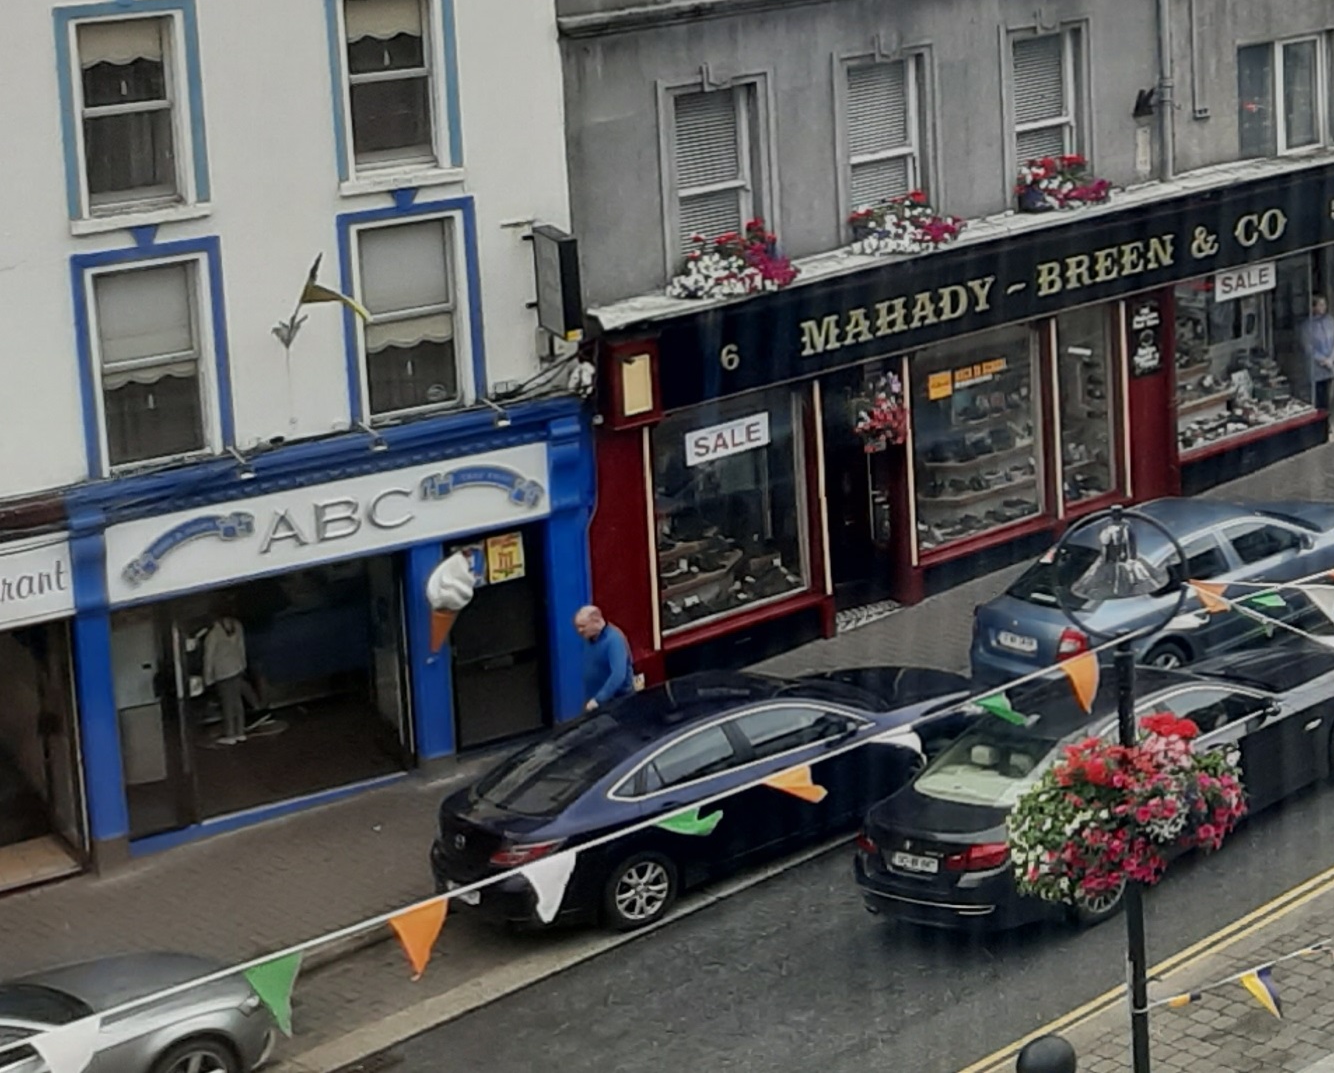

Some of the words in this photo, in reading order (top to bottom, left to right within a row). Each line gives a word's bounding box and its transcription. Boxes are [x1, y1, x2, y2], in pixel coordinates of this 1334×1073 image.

[800, 276, 996, 357] MAHADY
[1036, 233, 1175, 299] BREEN
[1190, 225, 1219, 259] &
[1233, 207, 1288, 247] CO
[1221, 267, 1270, 294] SALE
[721, 343, 740, 371] 6
[693, 421, 762, 458] SALE
[258, 488, 414, 555] ABC
